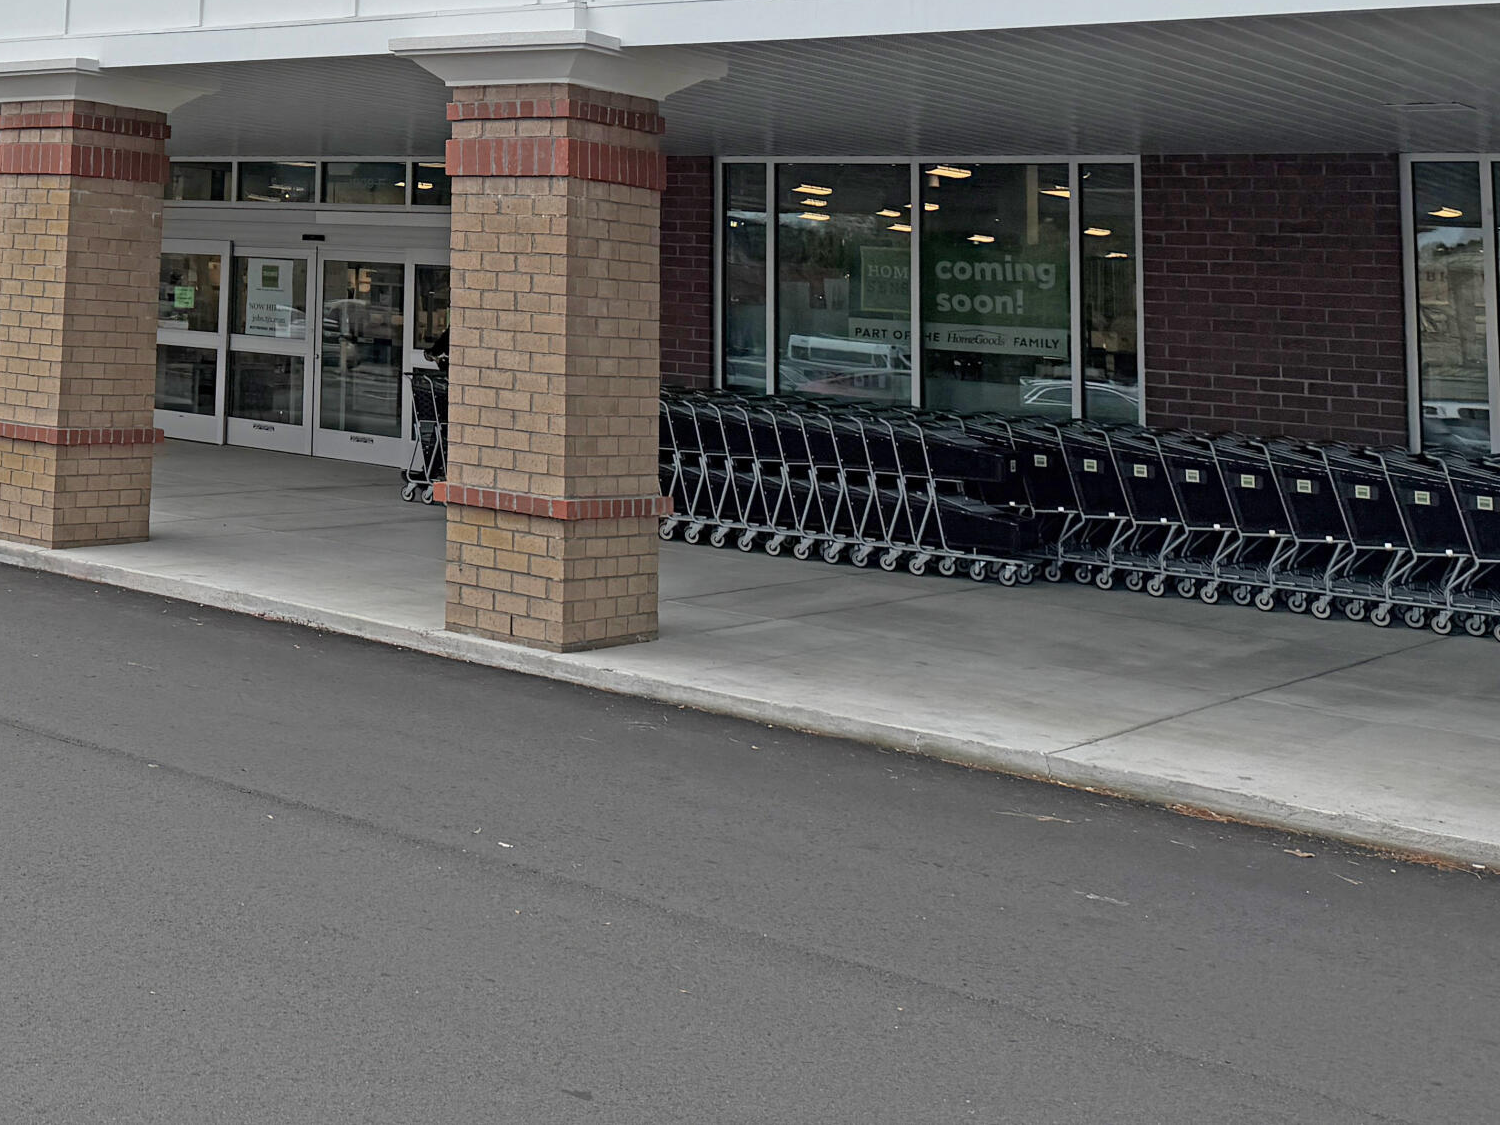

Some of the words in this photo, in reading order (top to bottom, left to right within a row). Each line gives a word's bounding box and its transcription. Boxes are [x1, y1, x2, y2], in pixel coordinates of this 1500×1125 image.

[867, 264, 909, 280] HOM
[934, 254, 1057, 290] coming
[935, 289, 1024, 315] soon!
[854, 327, 888, 339] PART
[892, 329, 911, 341] OF
[923, 332, 941, 343] HE
[947, 332, 1006, 346] HomeGoods
[1013, 337, 1060, 349] FAMILY
